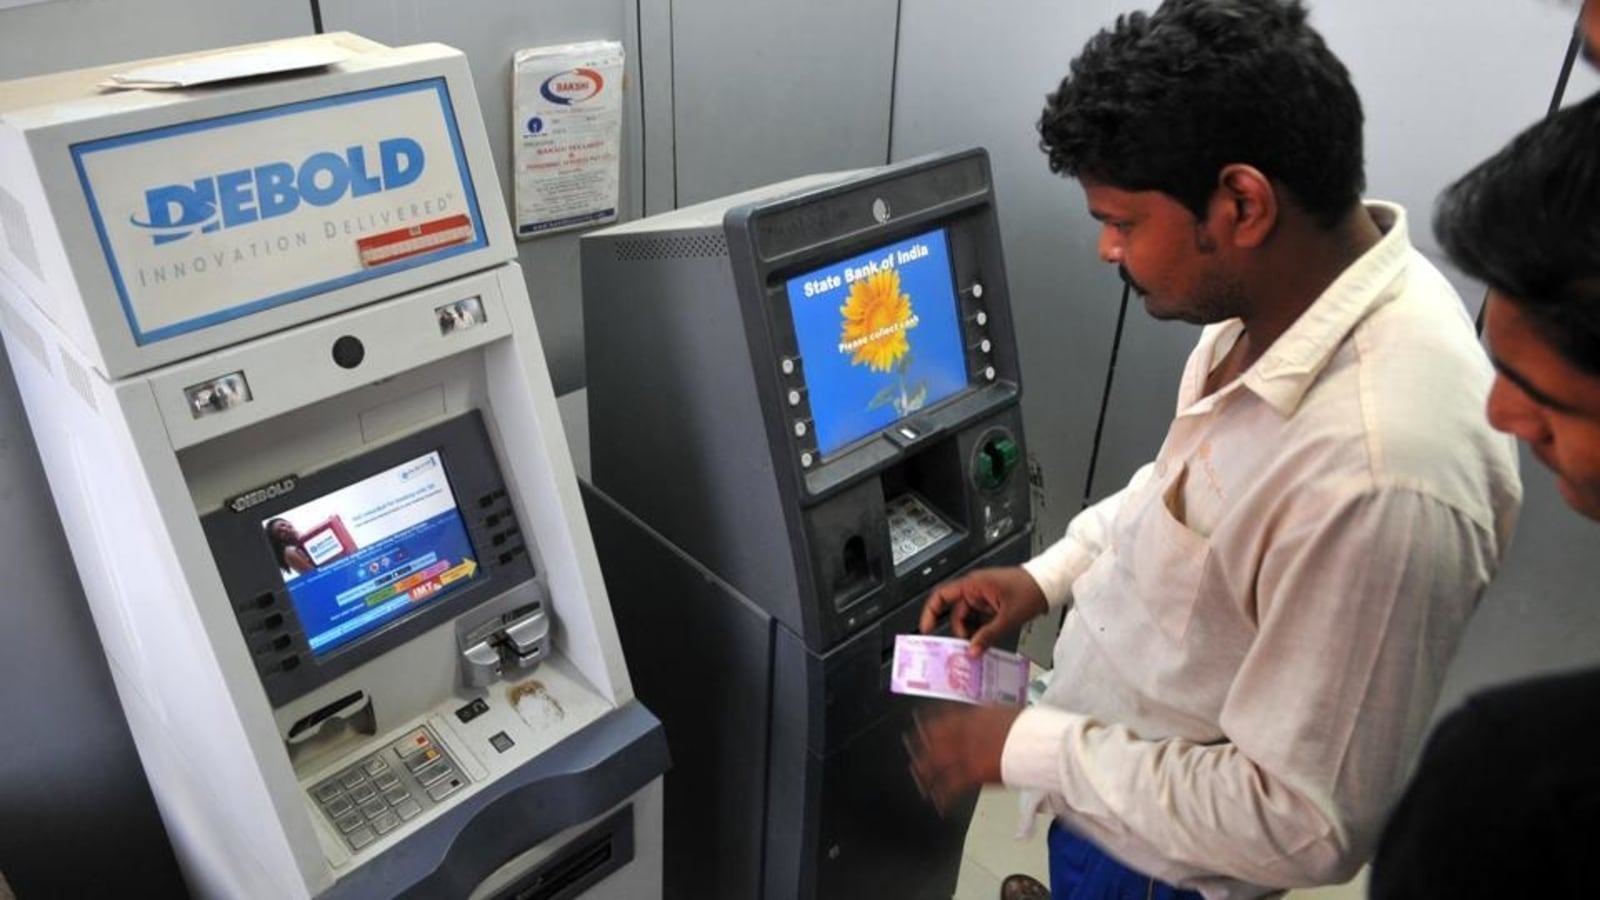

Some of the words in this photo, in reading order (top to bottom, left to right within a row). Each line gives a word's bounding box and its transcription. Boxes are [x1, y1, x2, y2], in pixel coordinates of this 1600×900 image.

[131, 137, 425, 246] DIEBOLD
[138, 231, 306, 288] INNOVATION
[323, 196, 449, 240] DELIVERED
[803, 275, 841, 298] State
[844, 260, 879, 283] Bank
[881, 253, 895, 270] of
[897, 244, 929, 265] India
[838, 338, 867, 353] Please
[869, 323, 898, 341] collect
[231, 479, 295, 512] DIEBOLD
